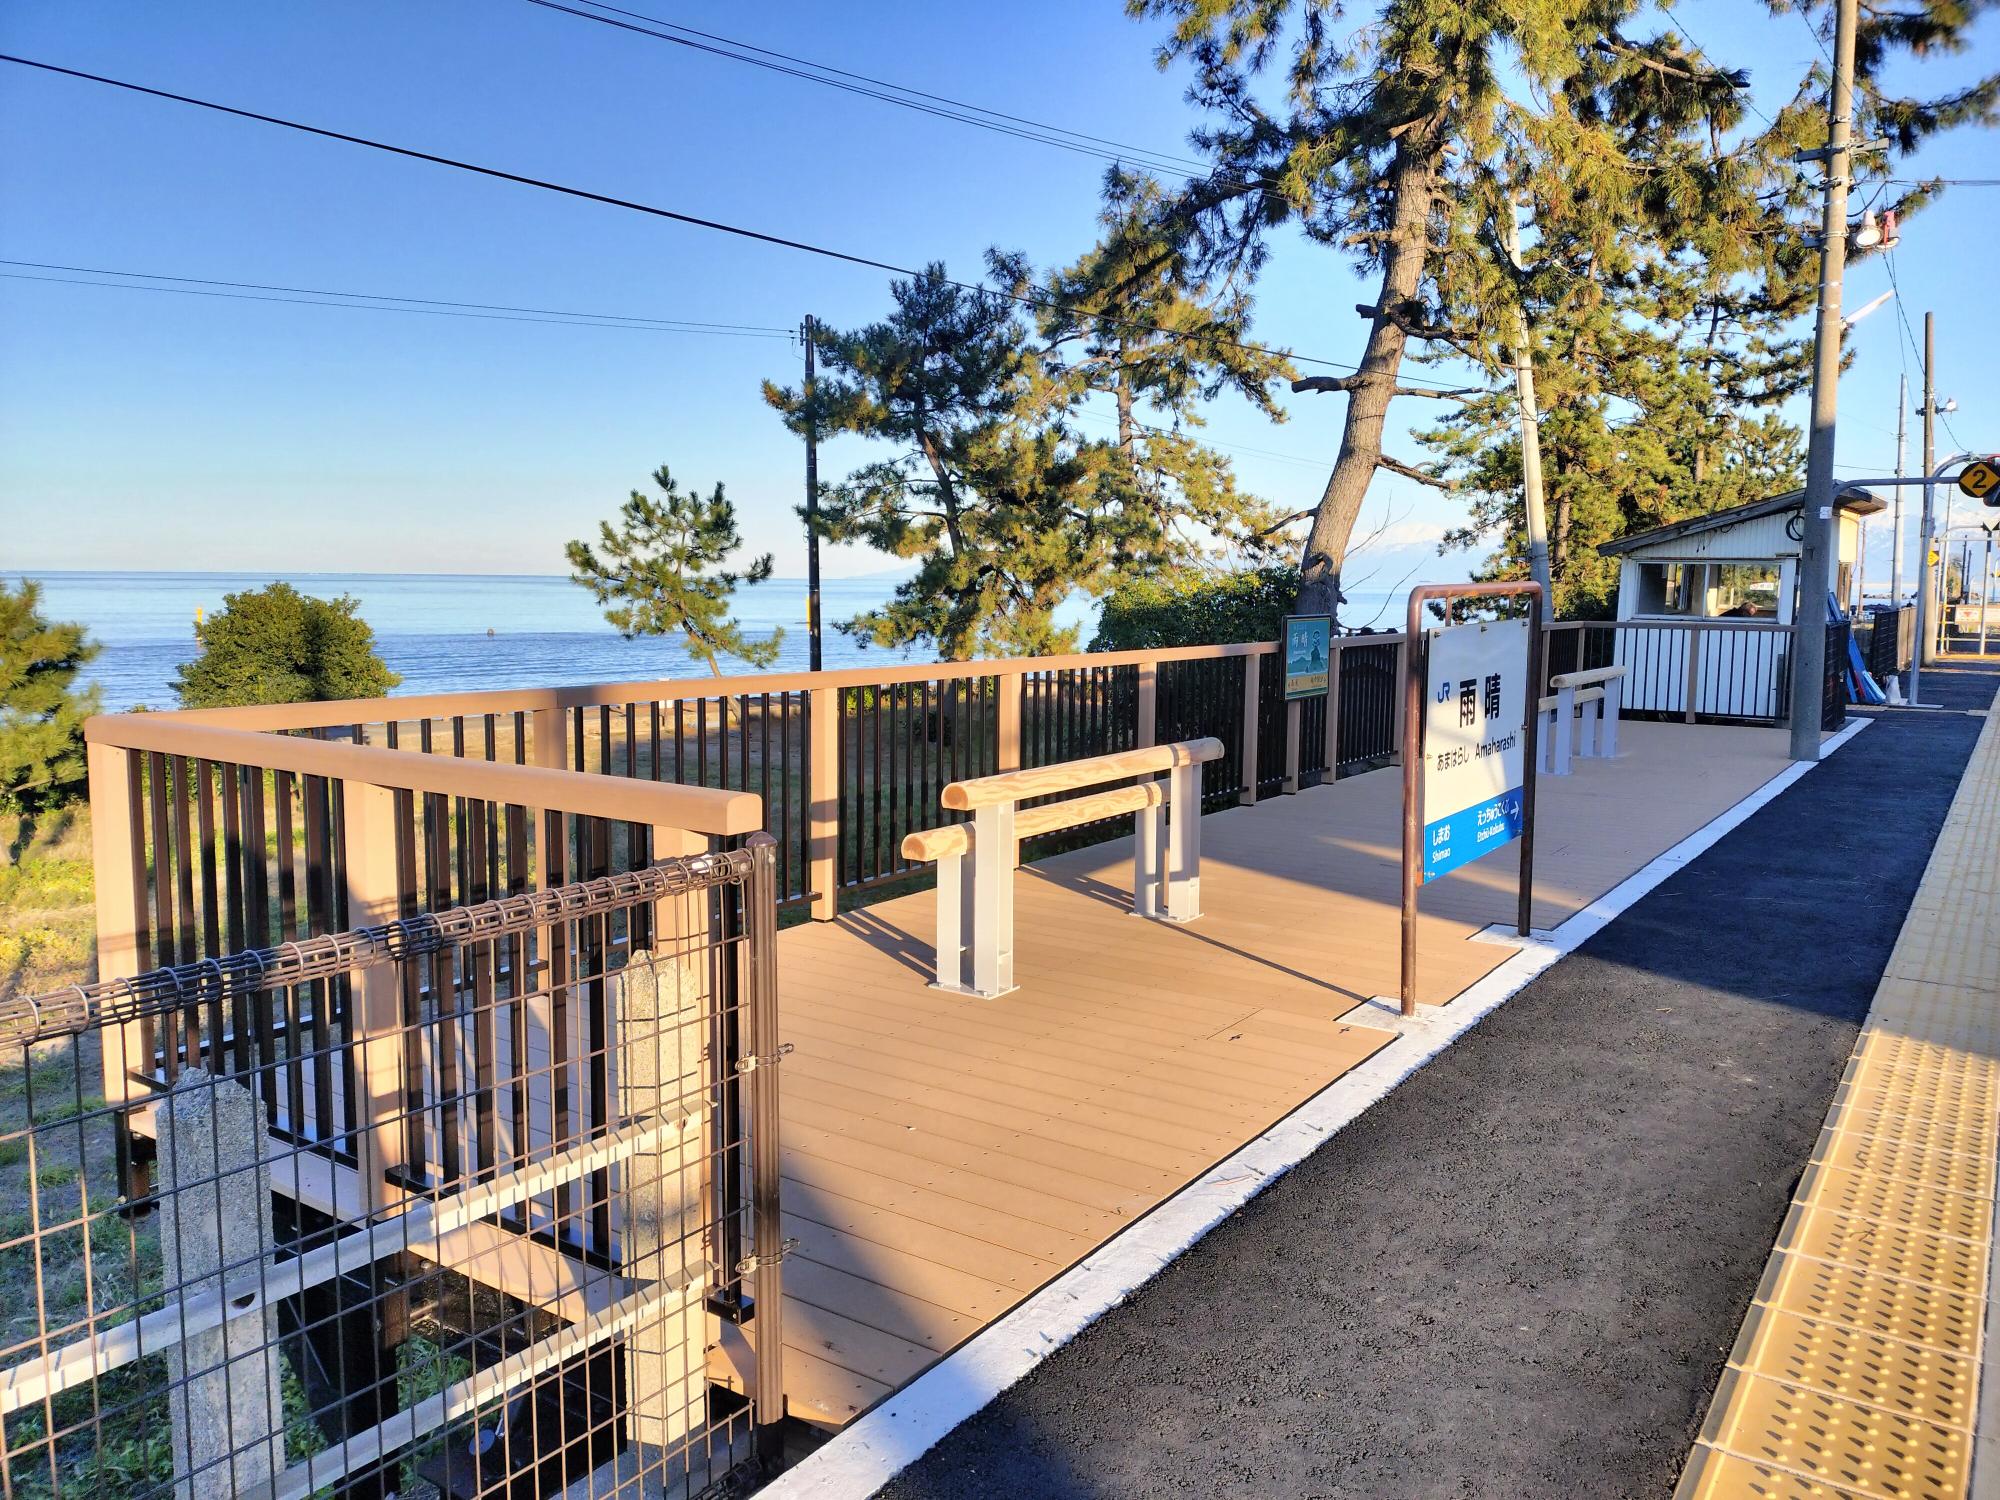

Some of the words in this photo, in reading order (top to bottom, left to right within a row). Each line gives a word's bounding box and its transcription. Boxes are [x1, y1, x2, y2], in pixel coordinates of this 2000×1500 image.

[1972, 469, 1987, 489] 2
[1438, 682, 1450, 703] JR
[1460, 673, 1501, 728] 雨晴
[1475, 731, 1516, 760] Amaharashi
[1437, 745, 1469, 771] あまはらし
[1432, 824, 1451, 846] しまお
[1432, 848, 1451, 864] Shimao
